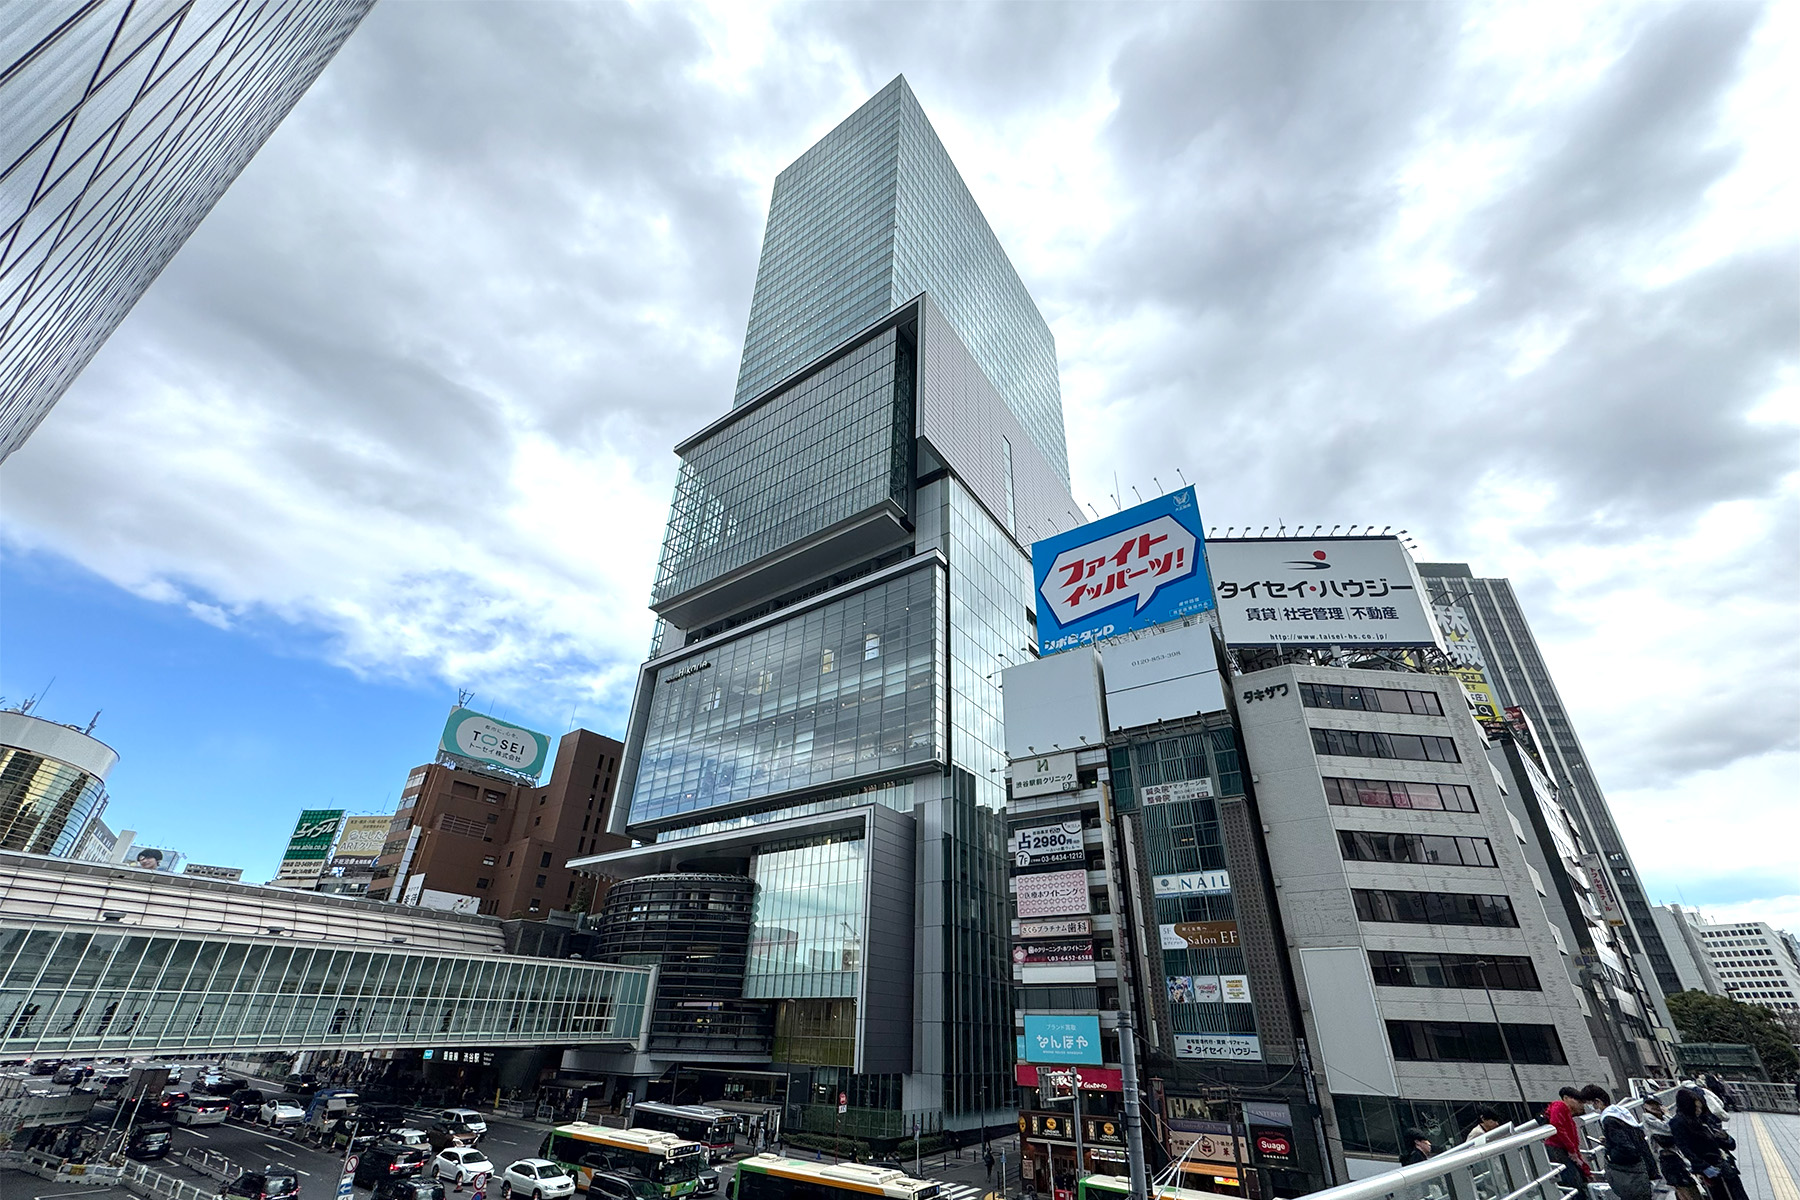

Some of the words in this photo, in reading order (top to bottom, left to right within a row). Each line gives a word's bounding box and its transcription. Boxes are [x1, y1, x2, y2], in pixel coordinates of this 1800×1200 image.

[1058, 533, 1168, 589] ファイト
[1061, 547, 1185, 608] イッパーツ!
[1217, 578, 1413, 599] タイセイ・ハウジー
[1246, 607, 1278, 621] 賃貸
[1283, 606, 1344, 621] 社宅管理
[1350, 606, 1399, 621] 不動産
[1269, 633, 1388, 641] http://www.taisei-hs.co.jp/
[1243, 683, 1288, 704] タキザワ
[469, 742, 521, 763] トーセイ株式会社
[1016, 773, 1073, 789] 渋谷駅前クリニック
[291, 818, 339, 838] エイブル
[1018, 832, 1031, 850] 占
[1181, 875, 1229, 890] NAIL
[1024, 887, 1079, 900] 医療ホワイトニング
[1022, 922, 1087, 934] さくらプラチナム歯科
[1187, 935, 1217, 945] Salon
[1220, 930, 1238, 944] EF
[1194, 1046, 1259, 1056] タイセイ・ハウジー
[1261, 1140, 1286, 1151] Suage
